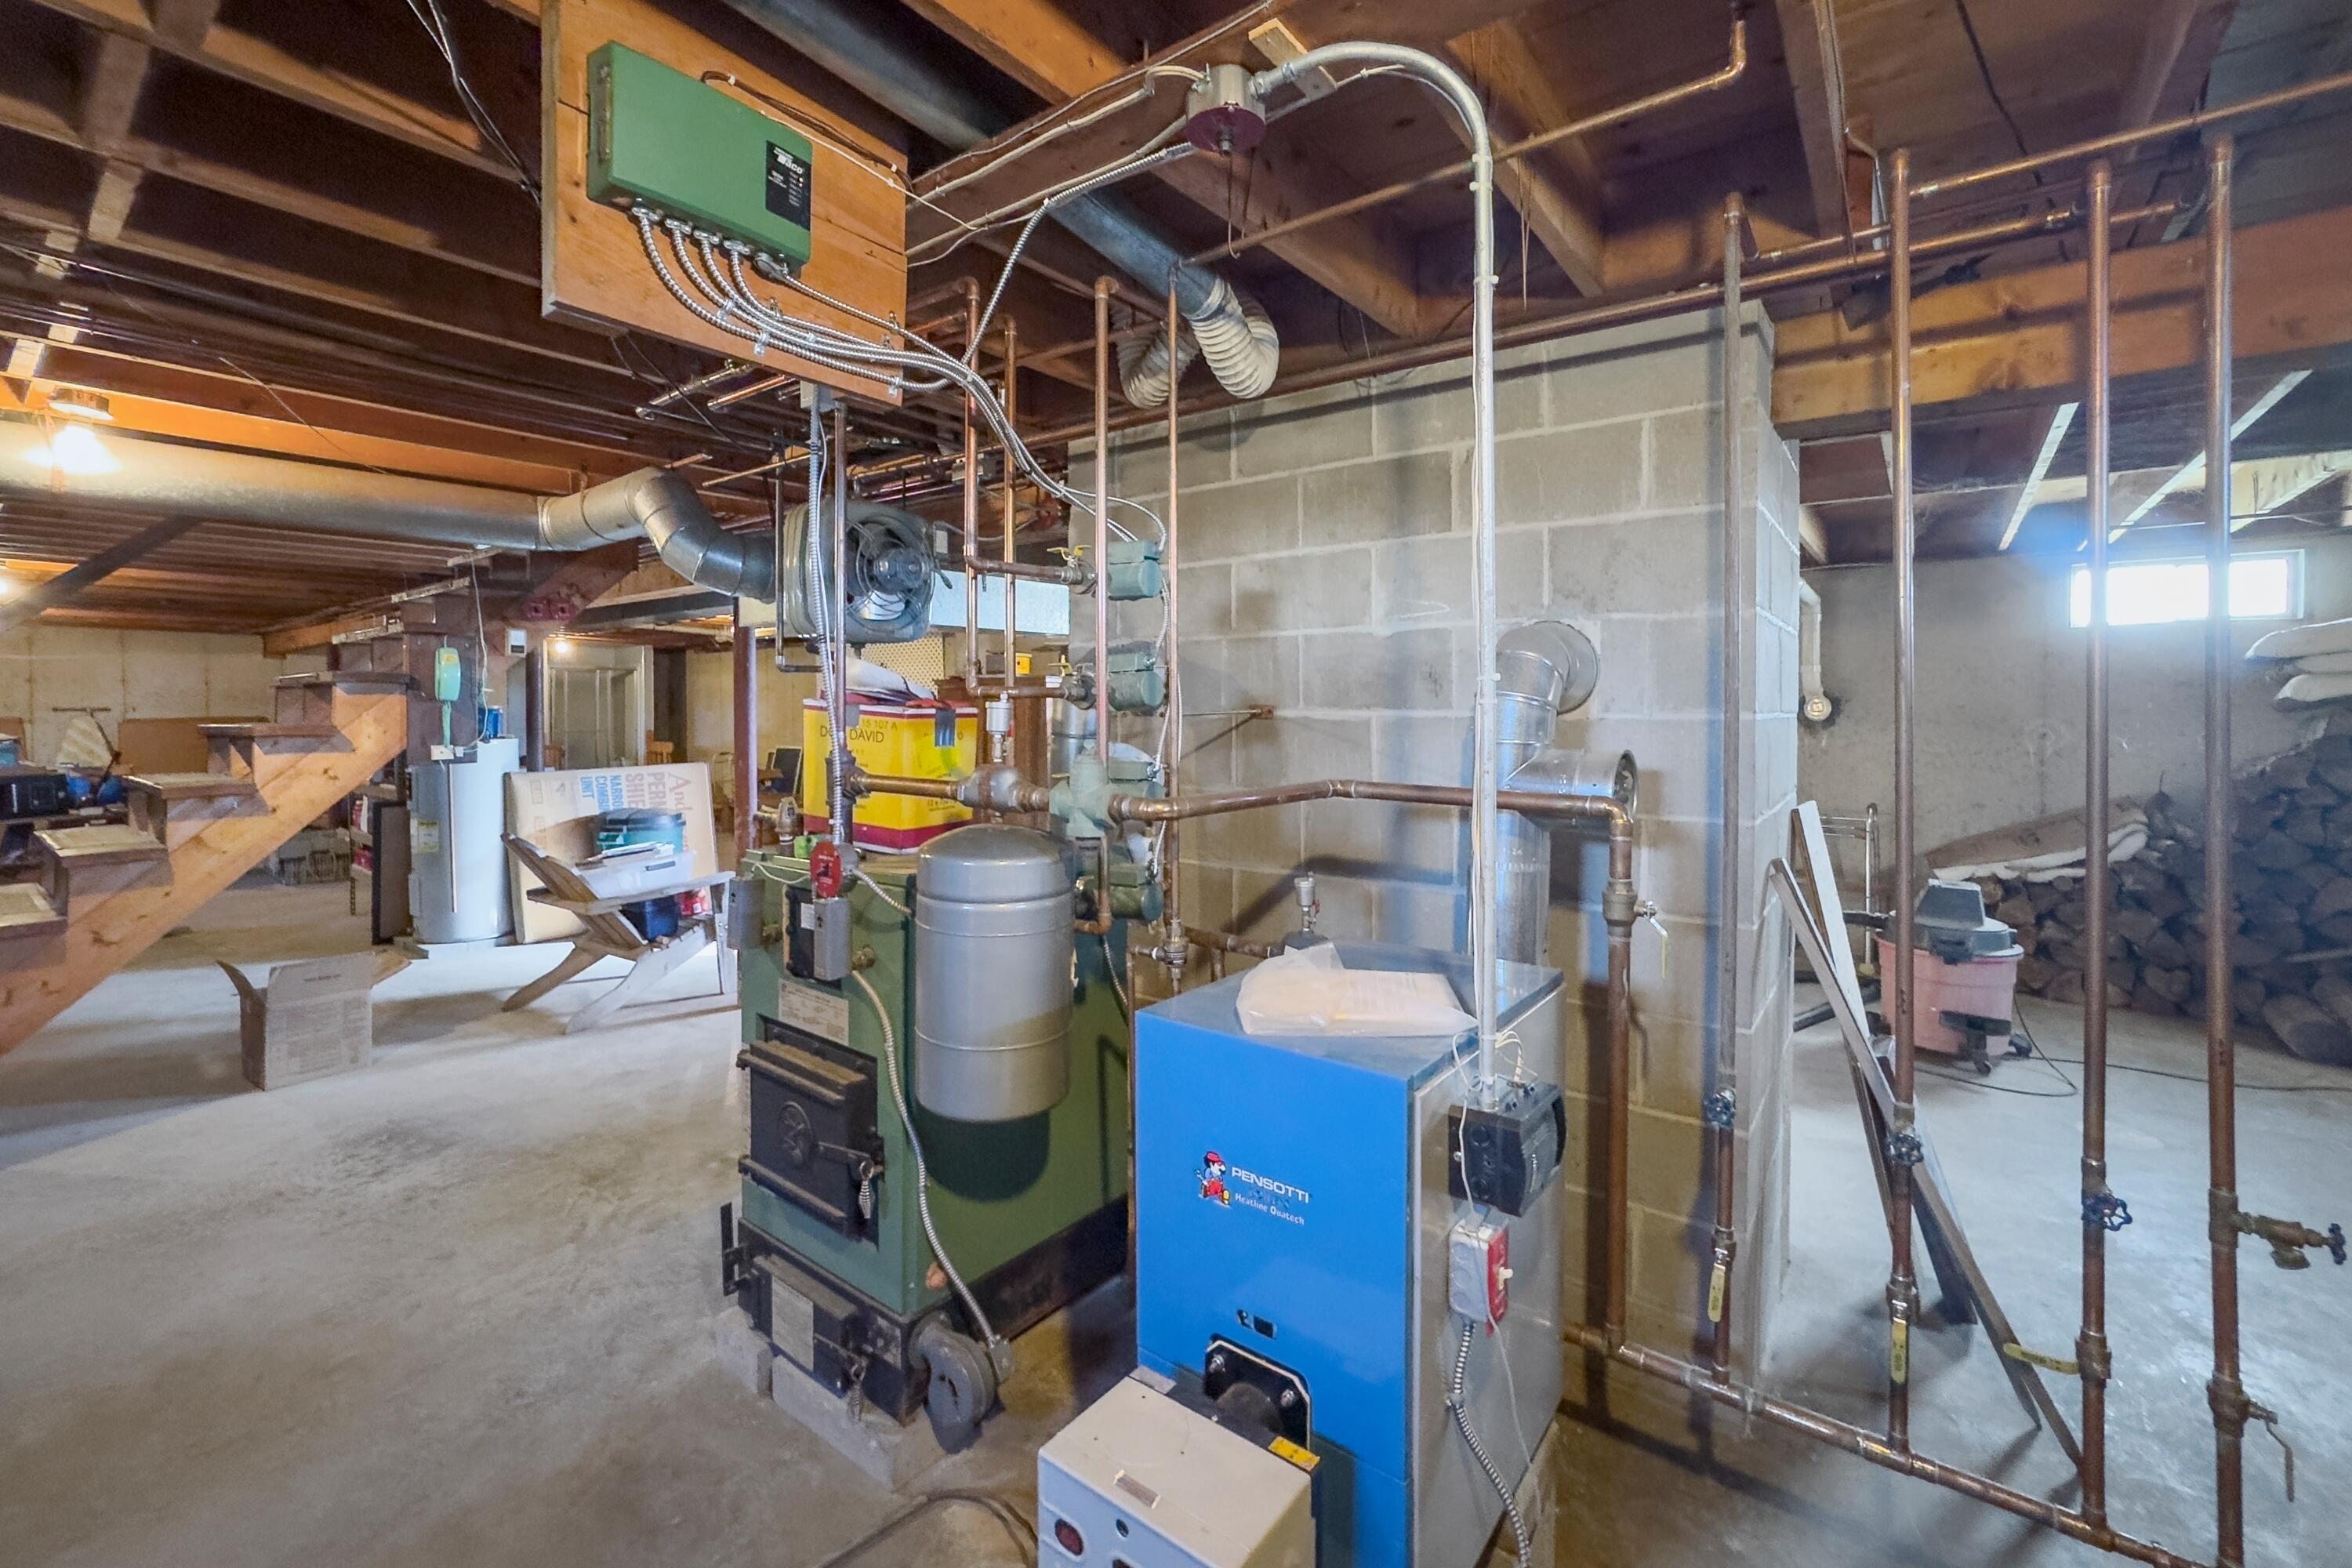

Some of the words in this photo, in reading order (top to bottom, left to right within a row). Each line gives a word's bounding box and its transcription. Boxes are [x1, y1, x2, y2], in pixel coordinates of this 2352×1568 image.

[774, 147, 803, 174] Taco
[850, 729, 884, 742] DAVID
[580, 775, 594, 799] UNIT
[1231, 1167, 1309, 1203] PENSOTTI
[1235, 1192, 1268, 1212] Heatline
[1270, 1206, 1305, 1225] Quatech
